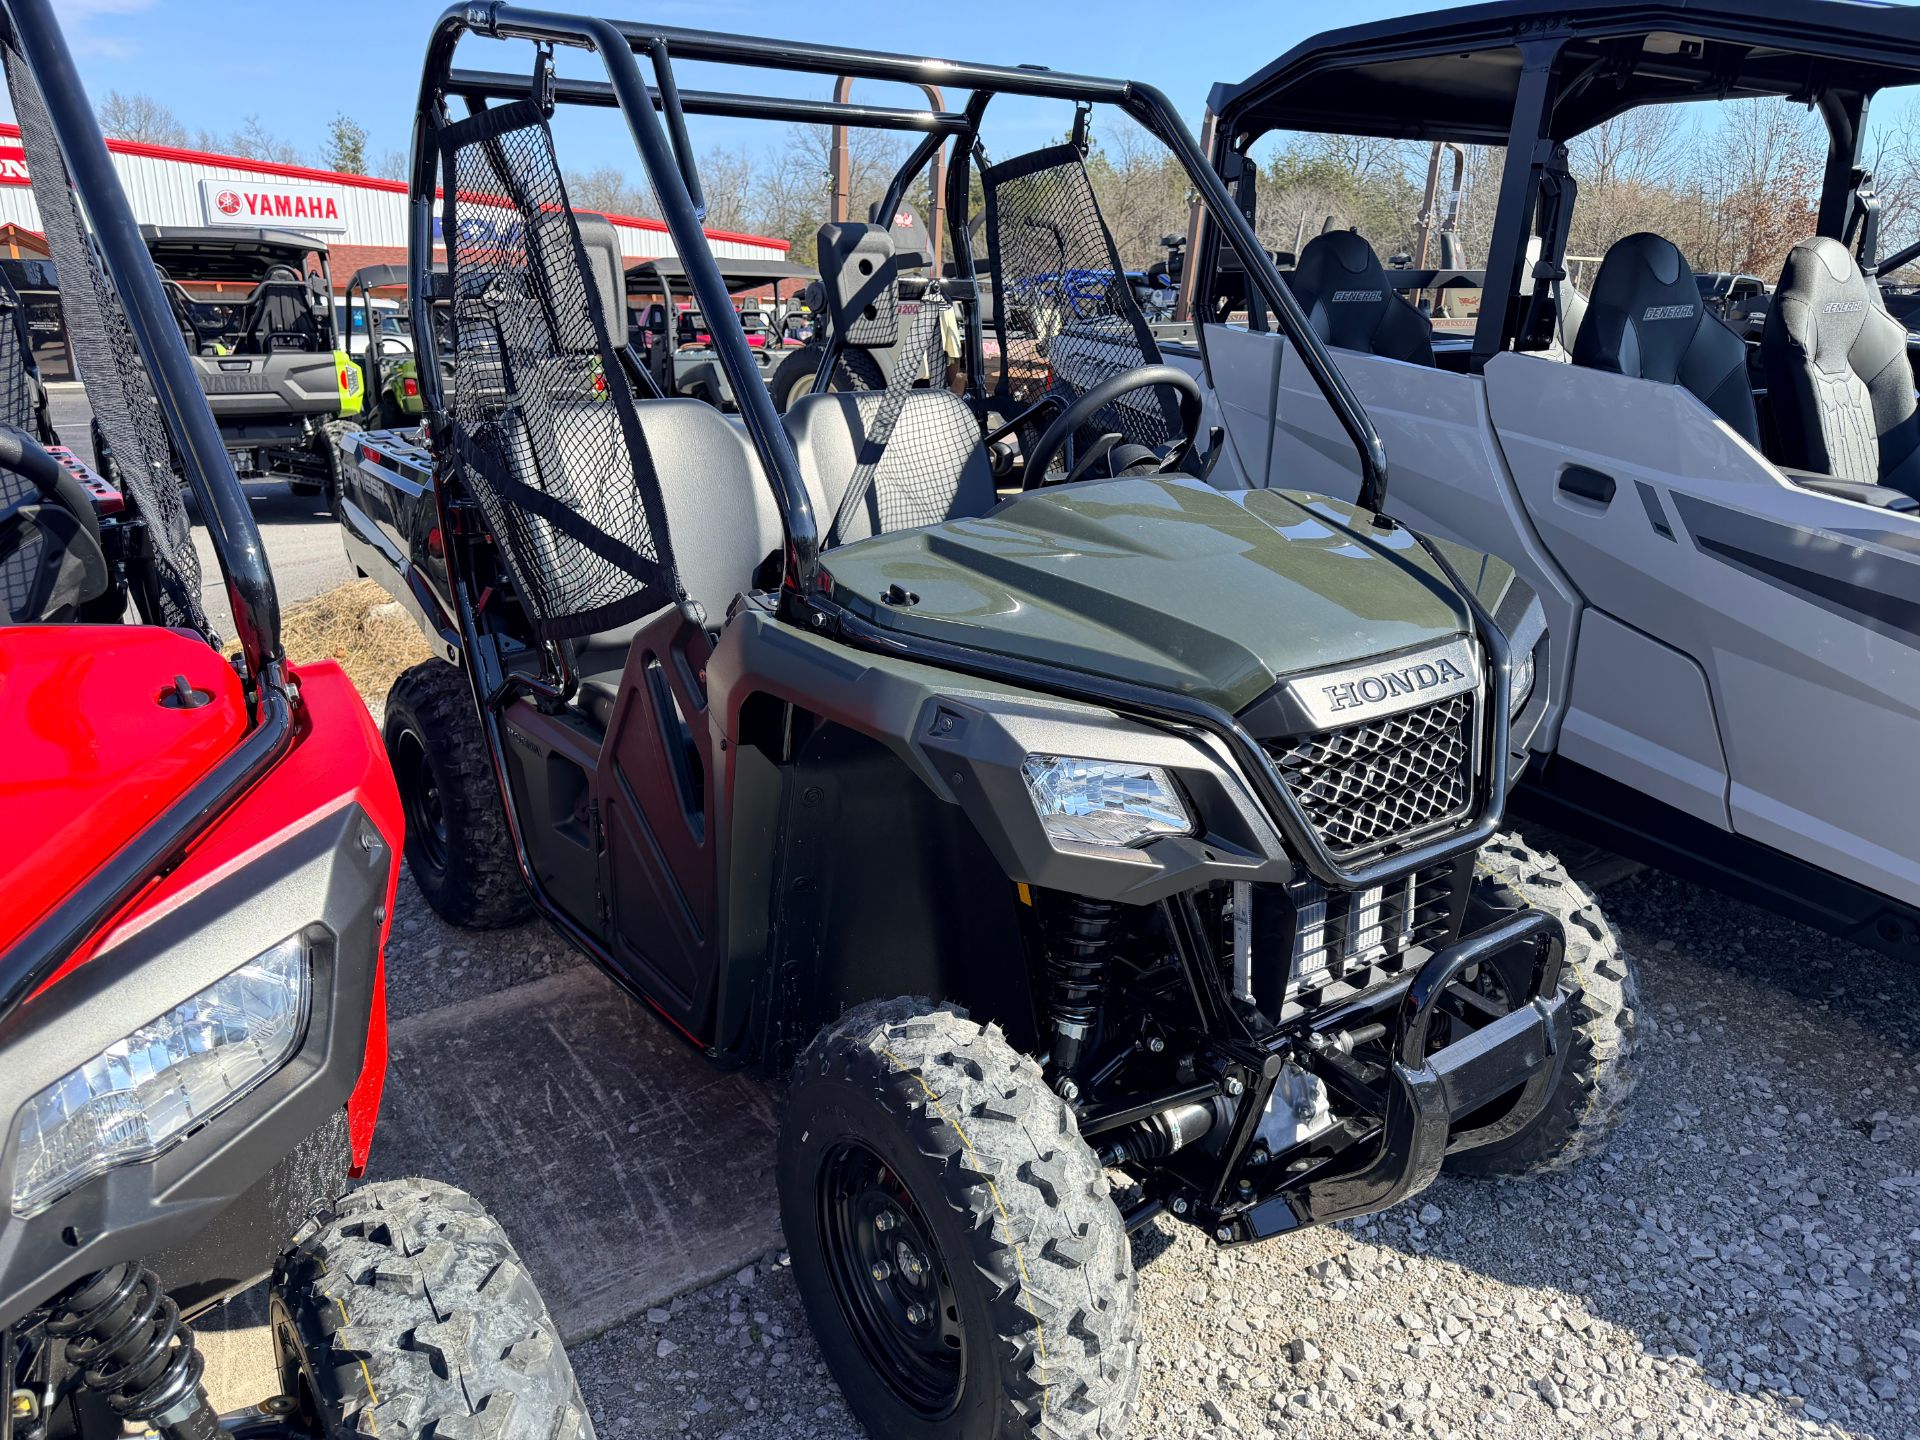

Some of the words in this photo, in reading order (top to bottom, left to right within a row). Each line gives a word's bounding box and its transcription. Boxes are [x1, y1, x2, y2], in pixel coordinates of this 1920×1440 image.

[243, 193, 339, 219] YAMAHA
[1332, 291, 1382, 302] GENERAL
[1643, 304, 1694, 321] GENERAL
[1822, 300, 1863, 314] GENERAL
[202, 373, 272, 392] YAMAHA
[343, 462, 385, 504] PIONEER
[1322, 658, 1466, 712] HONDA
